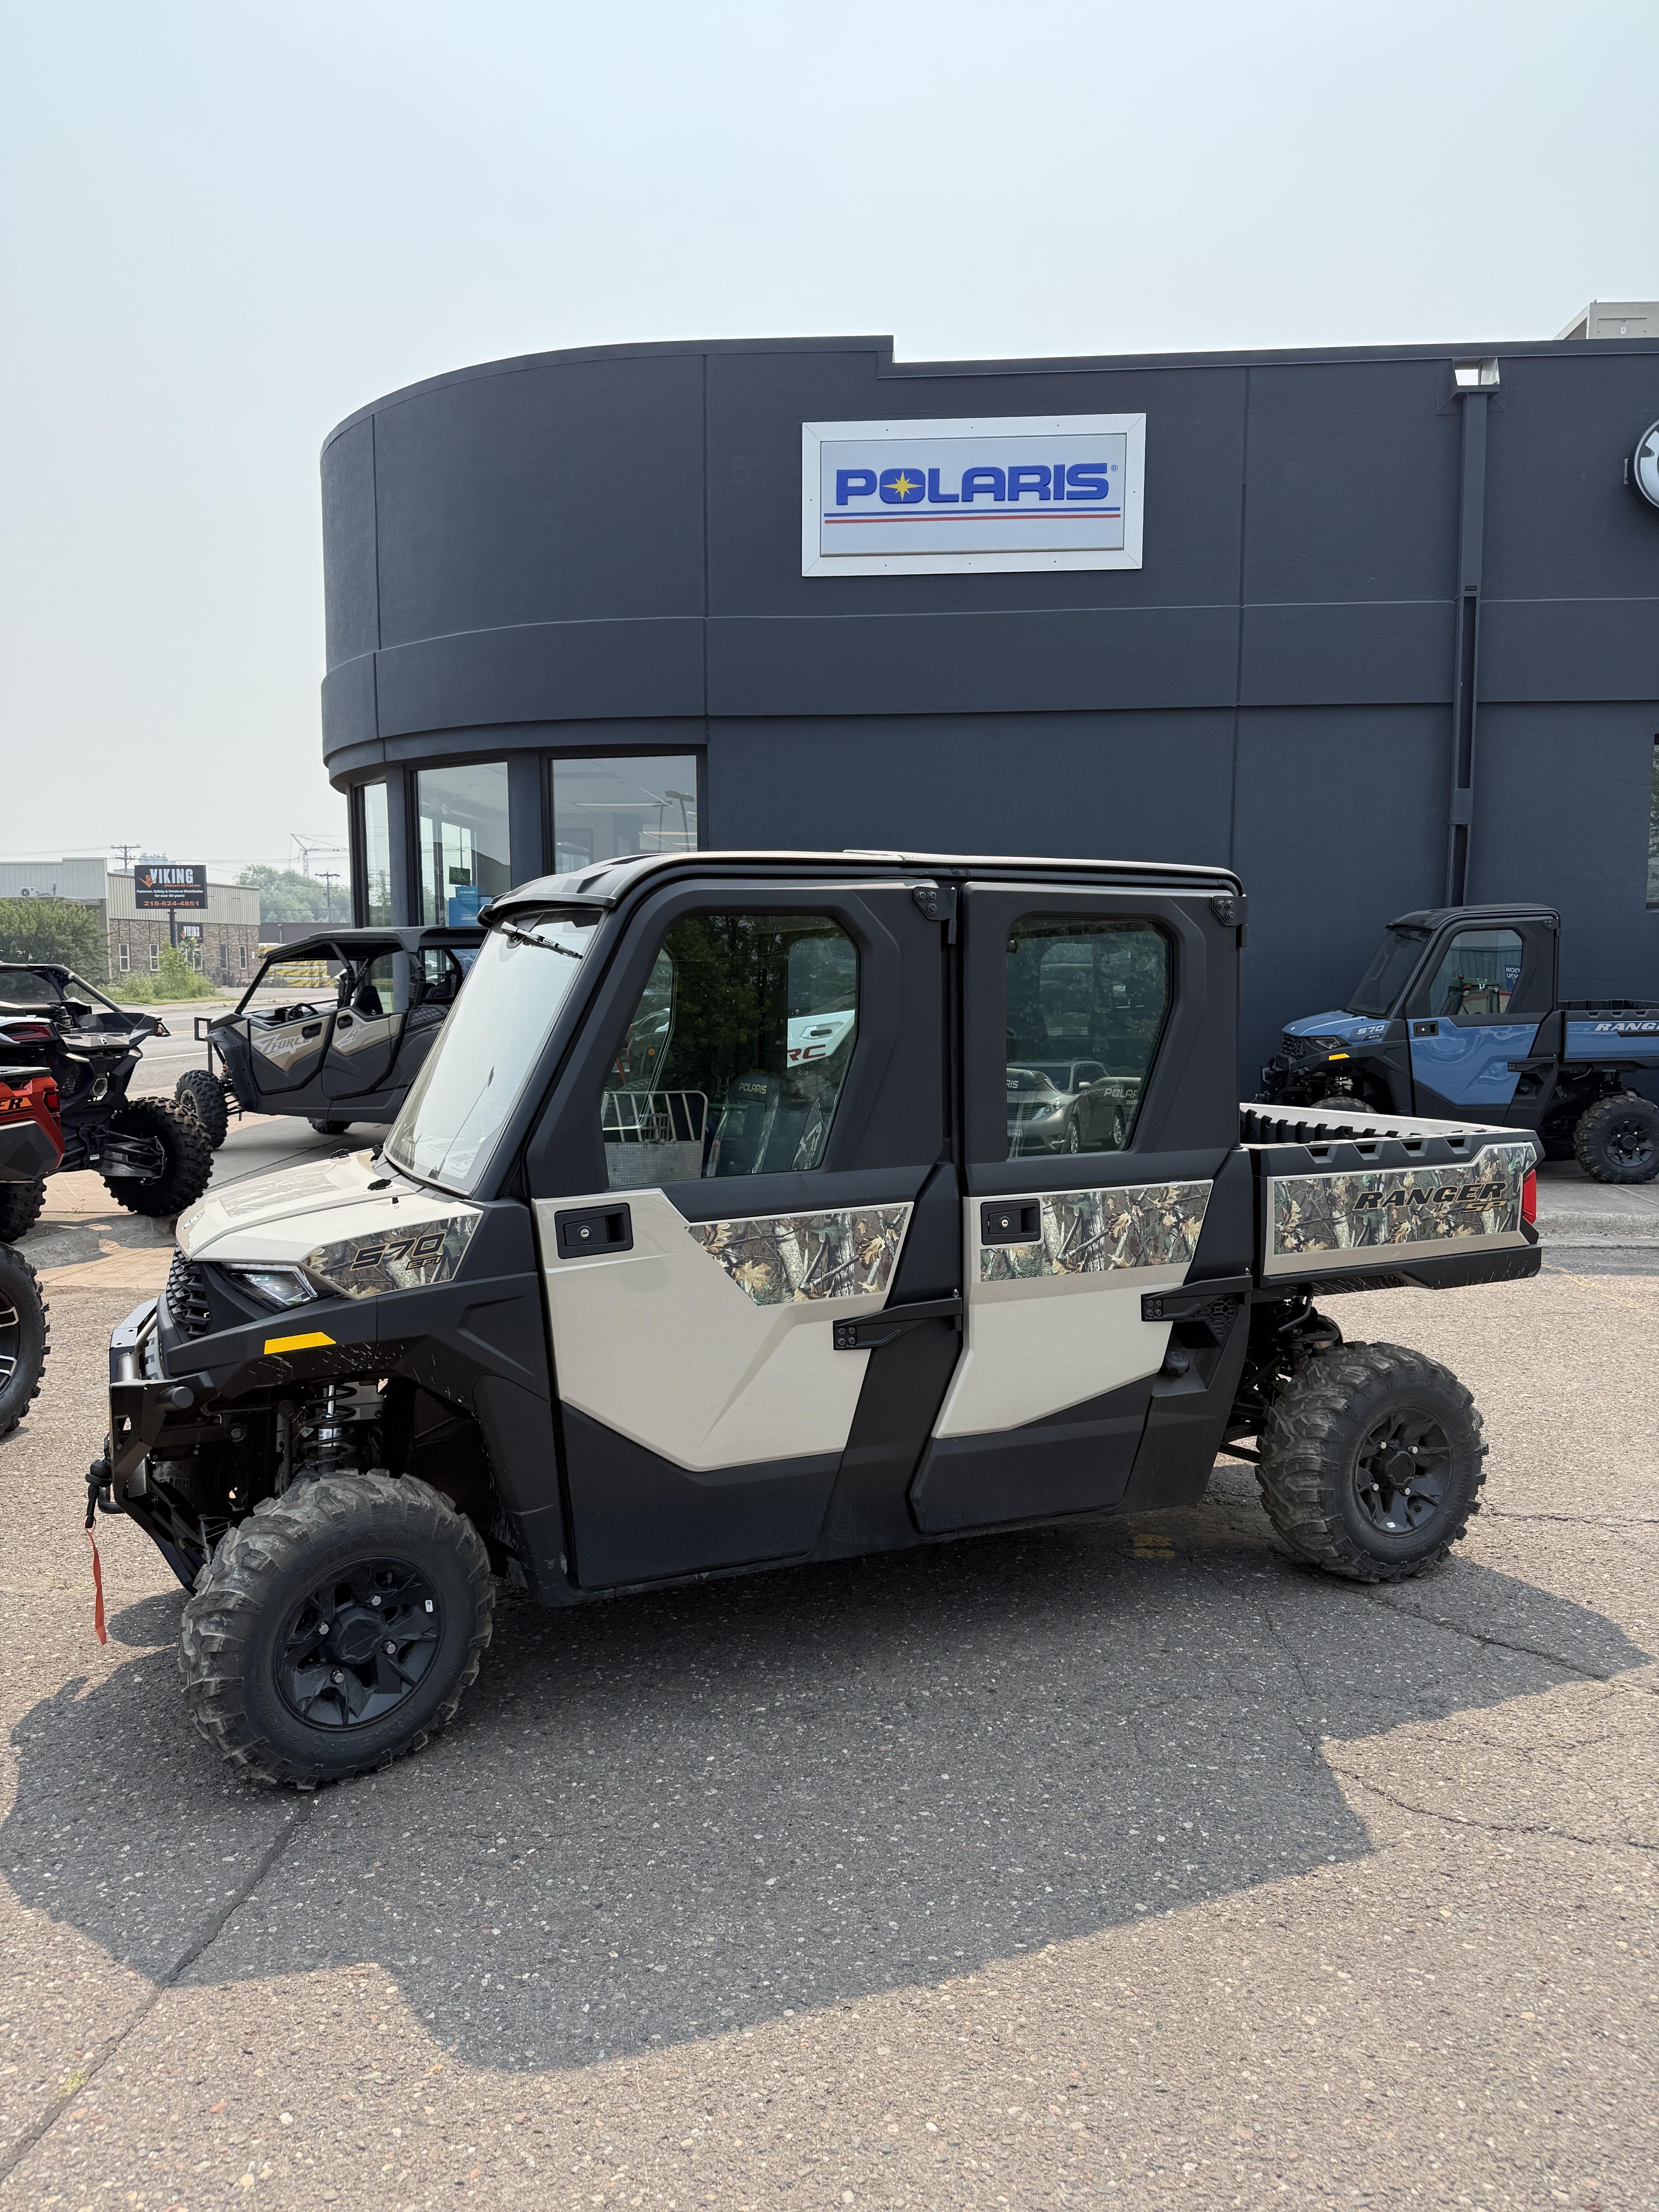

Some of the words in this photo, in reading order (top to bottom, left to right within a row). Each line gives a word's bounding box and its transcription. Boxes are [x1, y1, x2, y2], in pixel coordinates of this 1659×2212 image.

[836, 462, 1109, 505] POLARIS
[149, 869, 193, 884] VIKING
[1357, 1025, 1385, 1034] 570
[1595, 1022, 1659, 1031] RANG
[739, 1083, 767, 1094] POLARIS
[1352, 1182, 1506, 1211] RANGER
[1462, 1200, 1508, 1213] SP
[349, 1232, 447, 1271] 570
[405, 1254, 443, 1271] EFI
